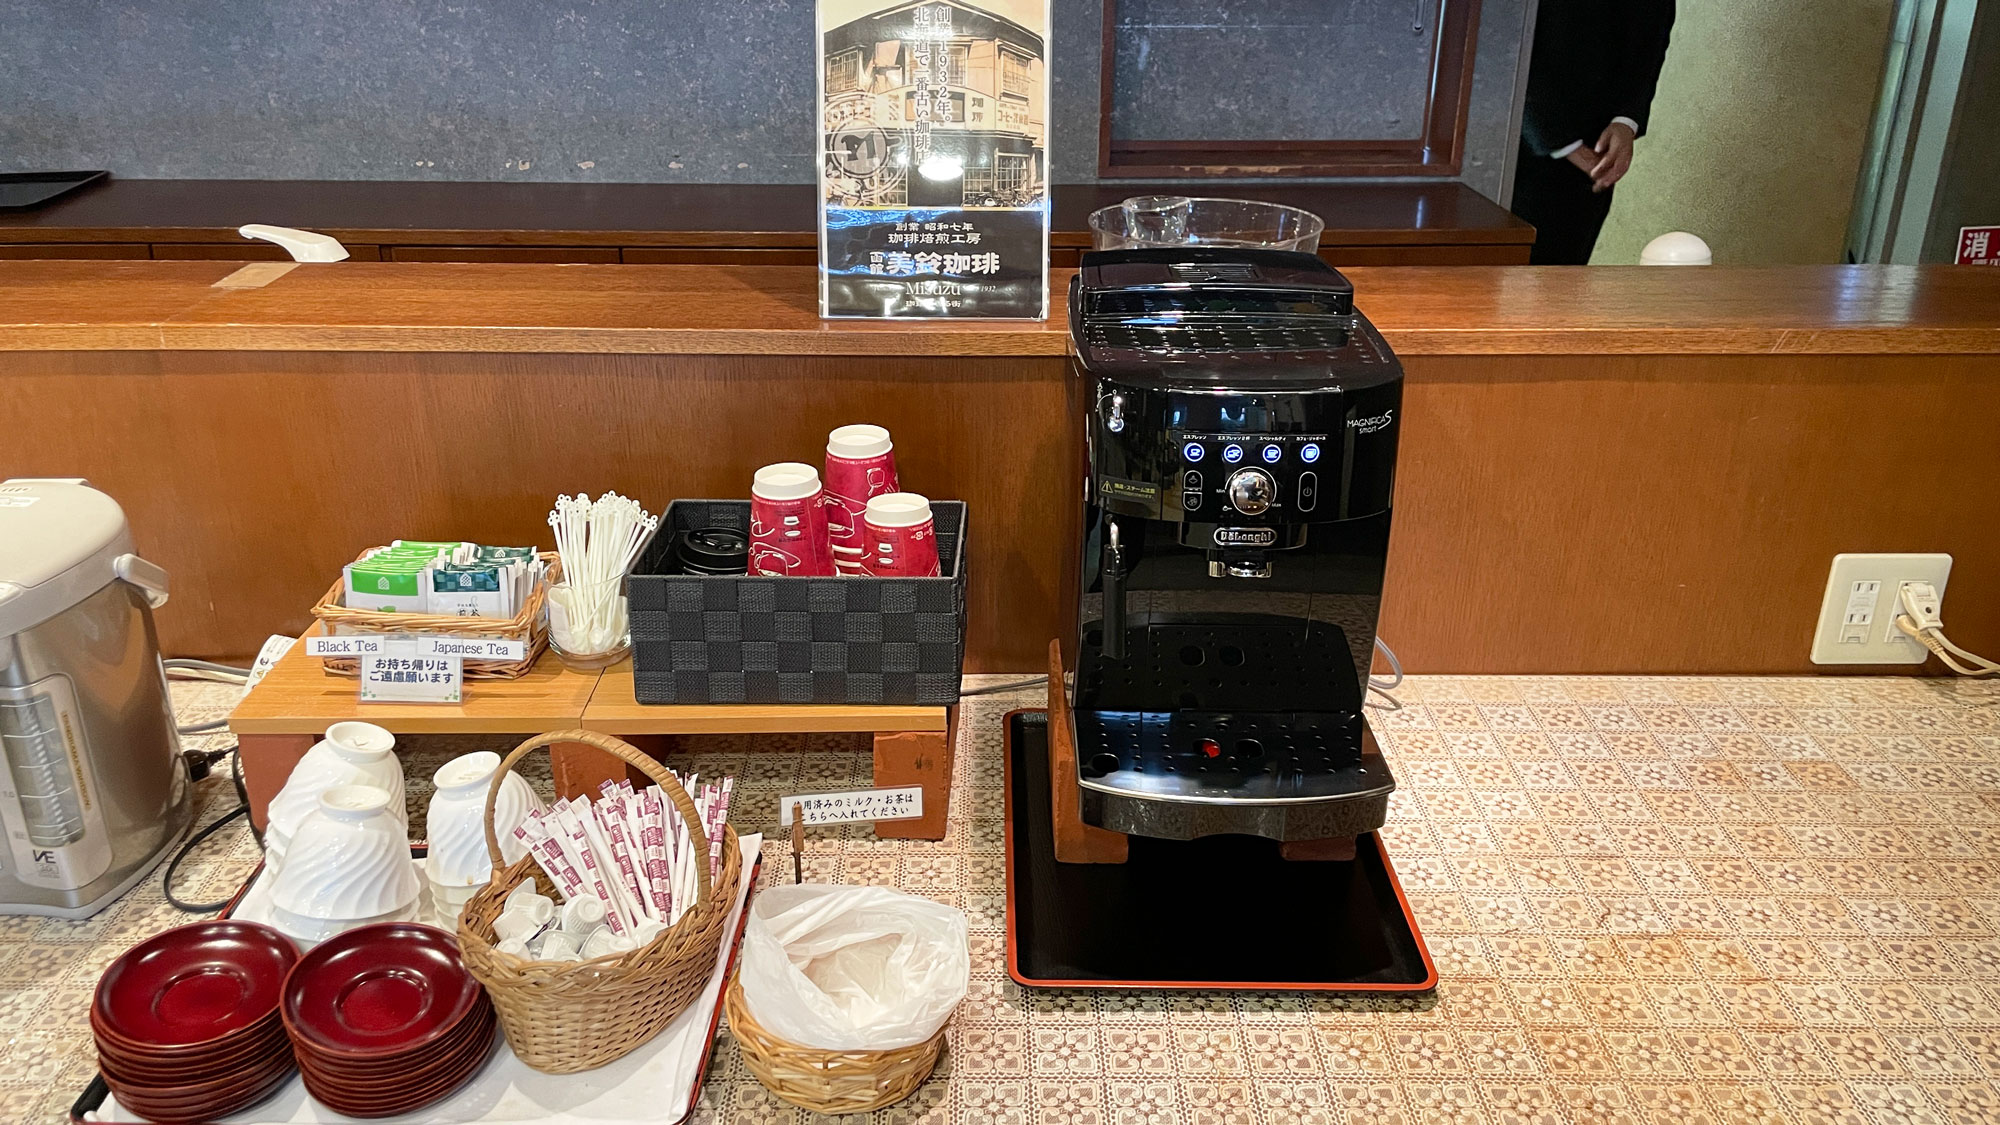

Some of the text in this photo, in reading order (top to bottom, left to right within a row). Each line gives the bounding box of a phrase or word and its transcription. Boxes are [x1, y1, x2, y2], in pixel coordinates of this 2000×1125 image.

[896, 222, 974, 231] 創業 昭和七年
[888, 233, 981, 244] 珈琲焙煎工房
[886, 251, 1000, 275] 美鈴珈琲
[906, 282, 961, 295] Misuzu
[317, 640, 378, 653] Black Tea
[432, 641, 509, 655] Japanese Tea
[375, 658, 448, 671] お持ち帰りは
[369, 670, 454, 684] ご遠慮願います
[794, 793, 913, 810] 用済みのミルク・お茶は
